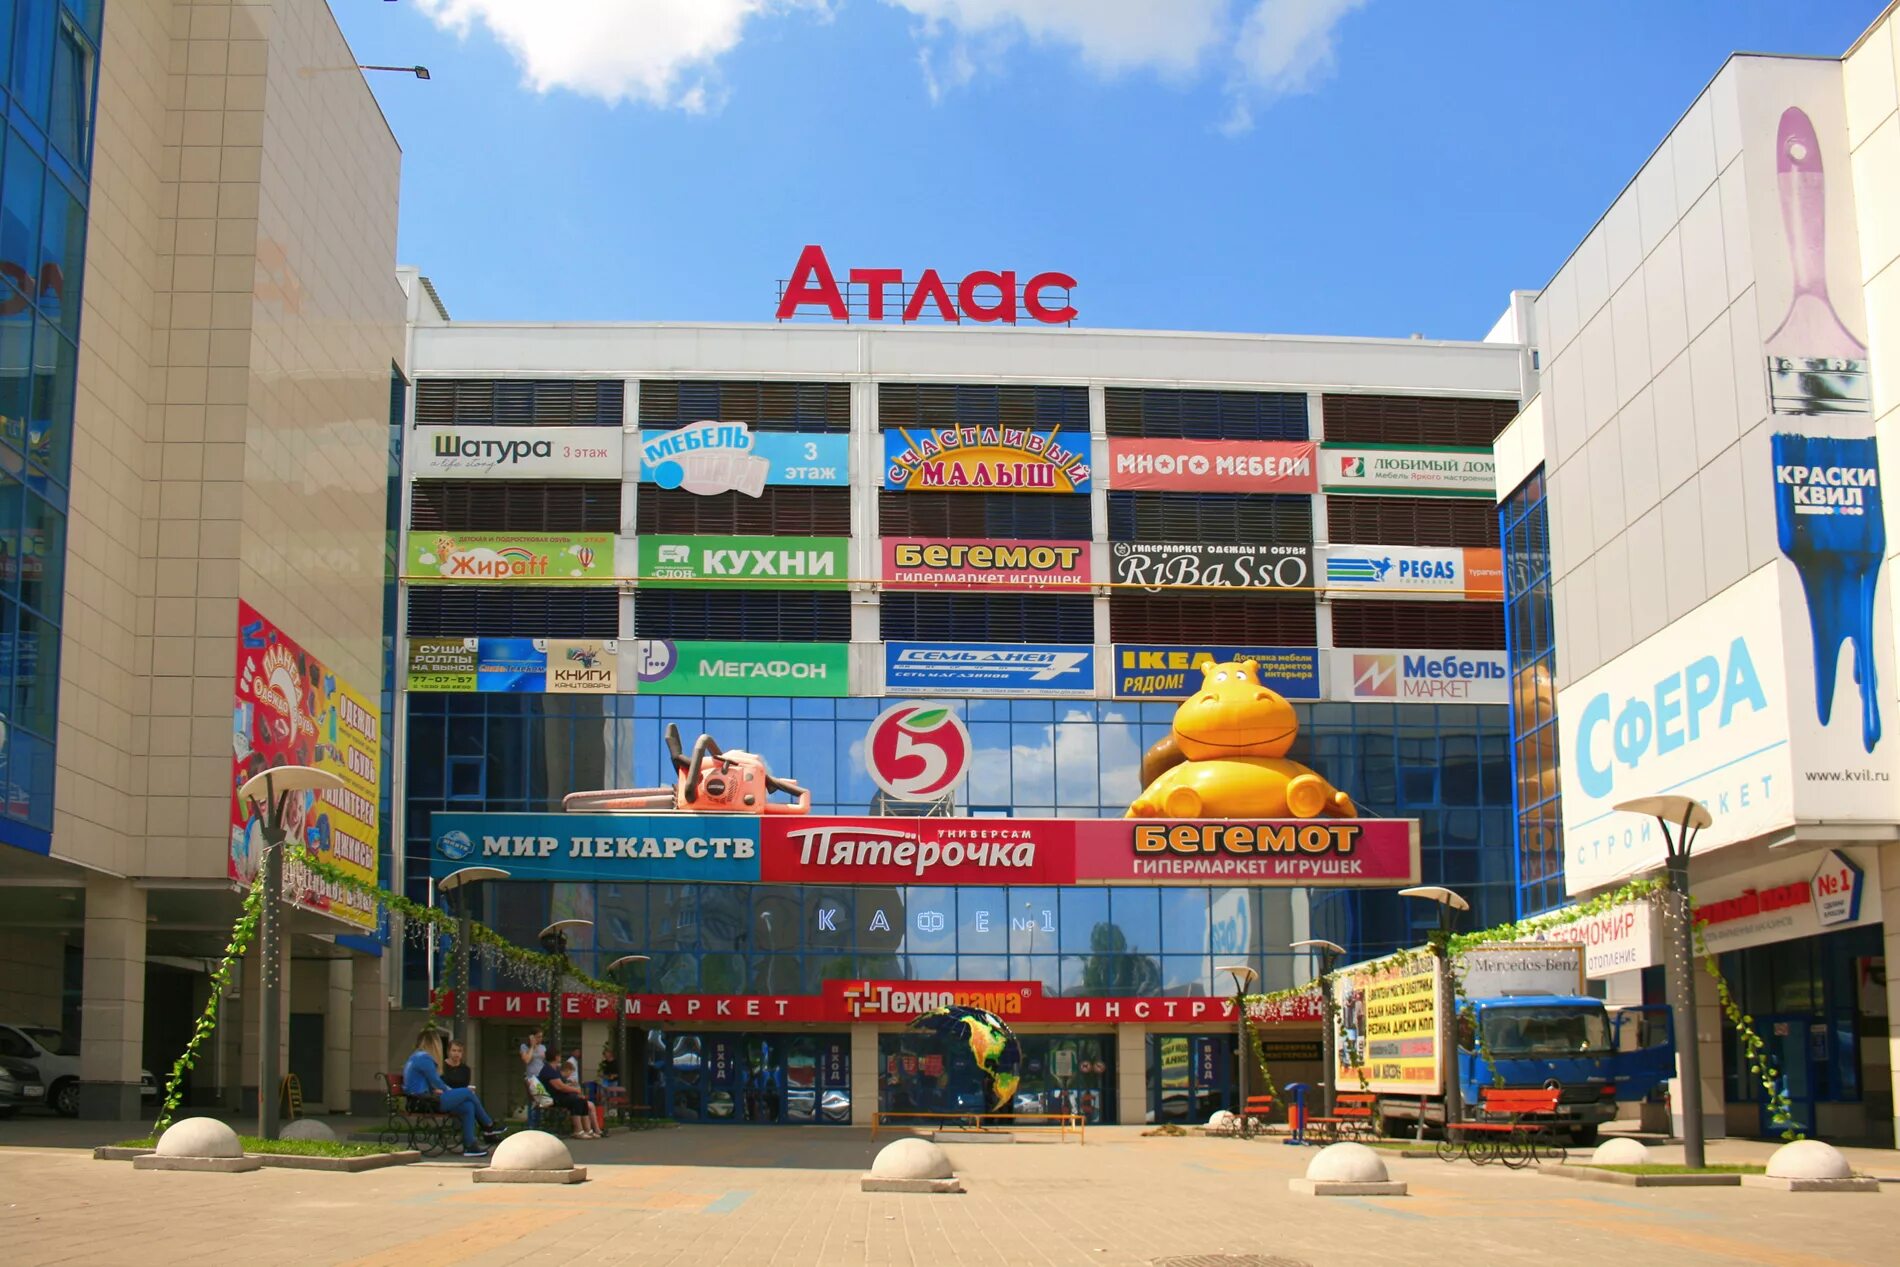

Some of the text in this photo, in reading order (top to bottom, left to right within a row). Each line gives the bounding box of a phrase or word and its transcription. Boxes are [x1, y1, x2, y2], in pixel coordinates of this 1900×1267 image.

[775, 245, 1079, 324] Атлас
[435, 436, 552, 463] Шатура
[563, 446, 608, 458] 3 этаж
[644, 426, 751, 462] МЕБЕЛЬ
[804, 442, 818, 461] 3
[888, 427, 1091, 485] СЧАСТЛИВЫЙ
[1117, 453, 1310, 477] МНОГО МЕБЕЛИ
[1374, 458, 1496, 473] ЛЮБИМЫЙ ДОМ
[785, 466, 836, 480] этаж
[921, 461, 1056, 488] МАЛЫШ
[1776, 464, 1877, 487] КРАСКИ
[1792, 486, 1864, 506] КВИЛ
[895, 544, 1081, 569] Бегемот
[1131, 544, 1306, 555] ГИПЕРМАРКЕТ ОДЕЖДЫ И ОБУВИ
[703, 550, 834, 576] КУХНИ
[1399, 560, 1455, 579] PEGAS
[895, 571, 1082, 589] гипермаркет игрушек
[415, 655, 472, 664] РОЛЛЫ
[420, 645, 467, 654] СУШИ
[908, 650, 1057, 662] СЕМЬ ДНЕЙ
[1233, 652, 1312, 662] Доставка мебели
[1122, 651, 1217, 670] IKEA
[1403, 655, 1505, 679] Мебель
[555, 670, 611, 681] КНИГИ
[1123, 674, 1185, 693] РЯДОМ!
[1264, 671, 1313, 680] интерьера
[554, 682, 612, 690] КАНЦТОВАРЫ
[1403, 680, 1472, 698] МАРКЕТ
[340, 693, 377, 743] ОДЕЖДА
[348, 744, 376, 785] ОБУВЬ
[1805, 769, 1890, 782] www.kvil.ru
[1577, 774, 1773, 865] СТРОЙКЕТ
[938, 829, 1032, 839] УНИВЕРСАМ
[1134, 824, 1361, 853] Бегемот
[333, 827, 373, 872] ДЖИНСЫ
[482, 835, 559, 857] МИР
[569, 836, 755, 859] ЛЕКАРСТВ
[1133, 858, 1363, 876] ГИПЕРМАРКЕТ ИГРУШЕК
[817, 909, 990, 932] КАФЕ
[1474, 957, 1579, 973] Mercedes-Benz
[1588, 948, 1637, 970] ОТОПЛЕНИЕ
[478, 996, 788, 1016] ГИПЕРМАРКЕТ
[717, 1044, 726, 1079] ВХОД
[831, 1045, 840, 1081] ВХОД
[1204, 1044, 1213, 1080] ВХОД
